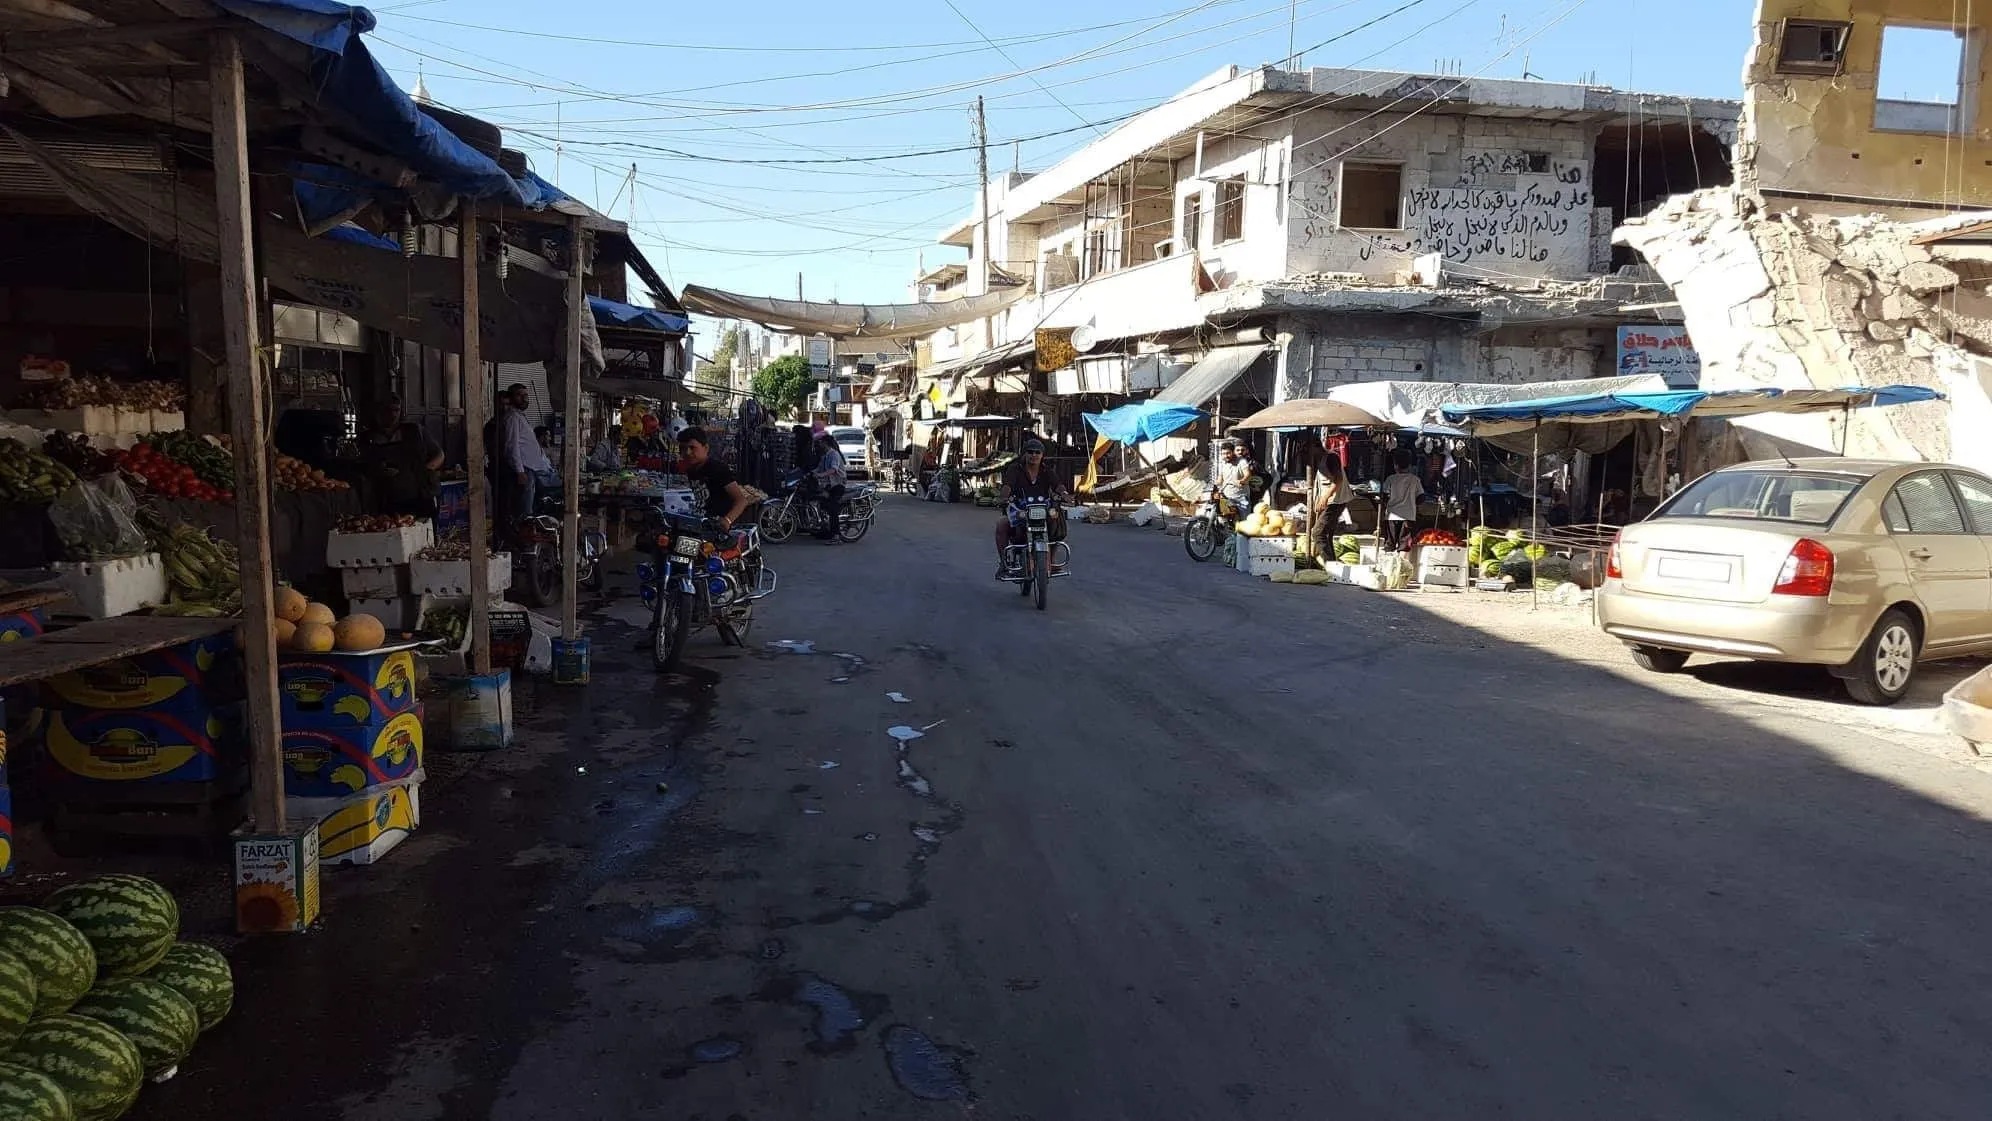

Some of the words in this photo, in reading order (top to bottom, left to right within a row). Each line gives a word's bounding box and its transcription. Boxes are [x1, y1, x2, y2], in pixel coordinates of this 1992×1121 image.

[1553, 161, 1581, 184] هنا
[1563, 188, 1588, 211] على
[1529, 239, 1548, 262] هنا
[241, 844, 290, 857] FARZAT
